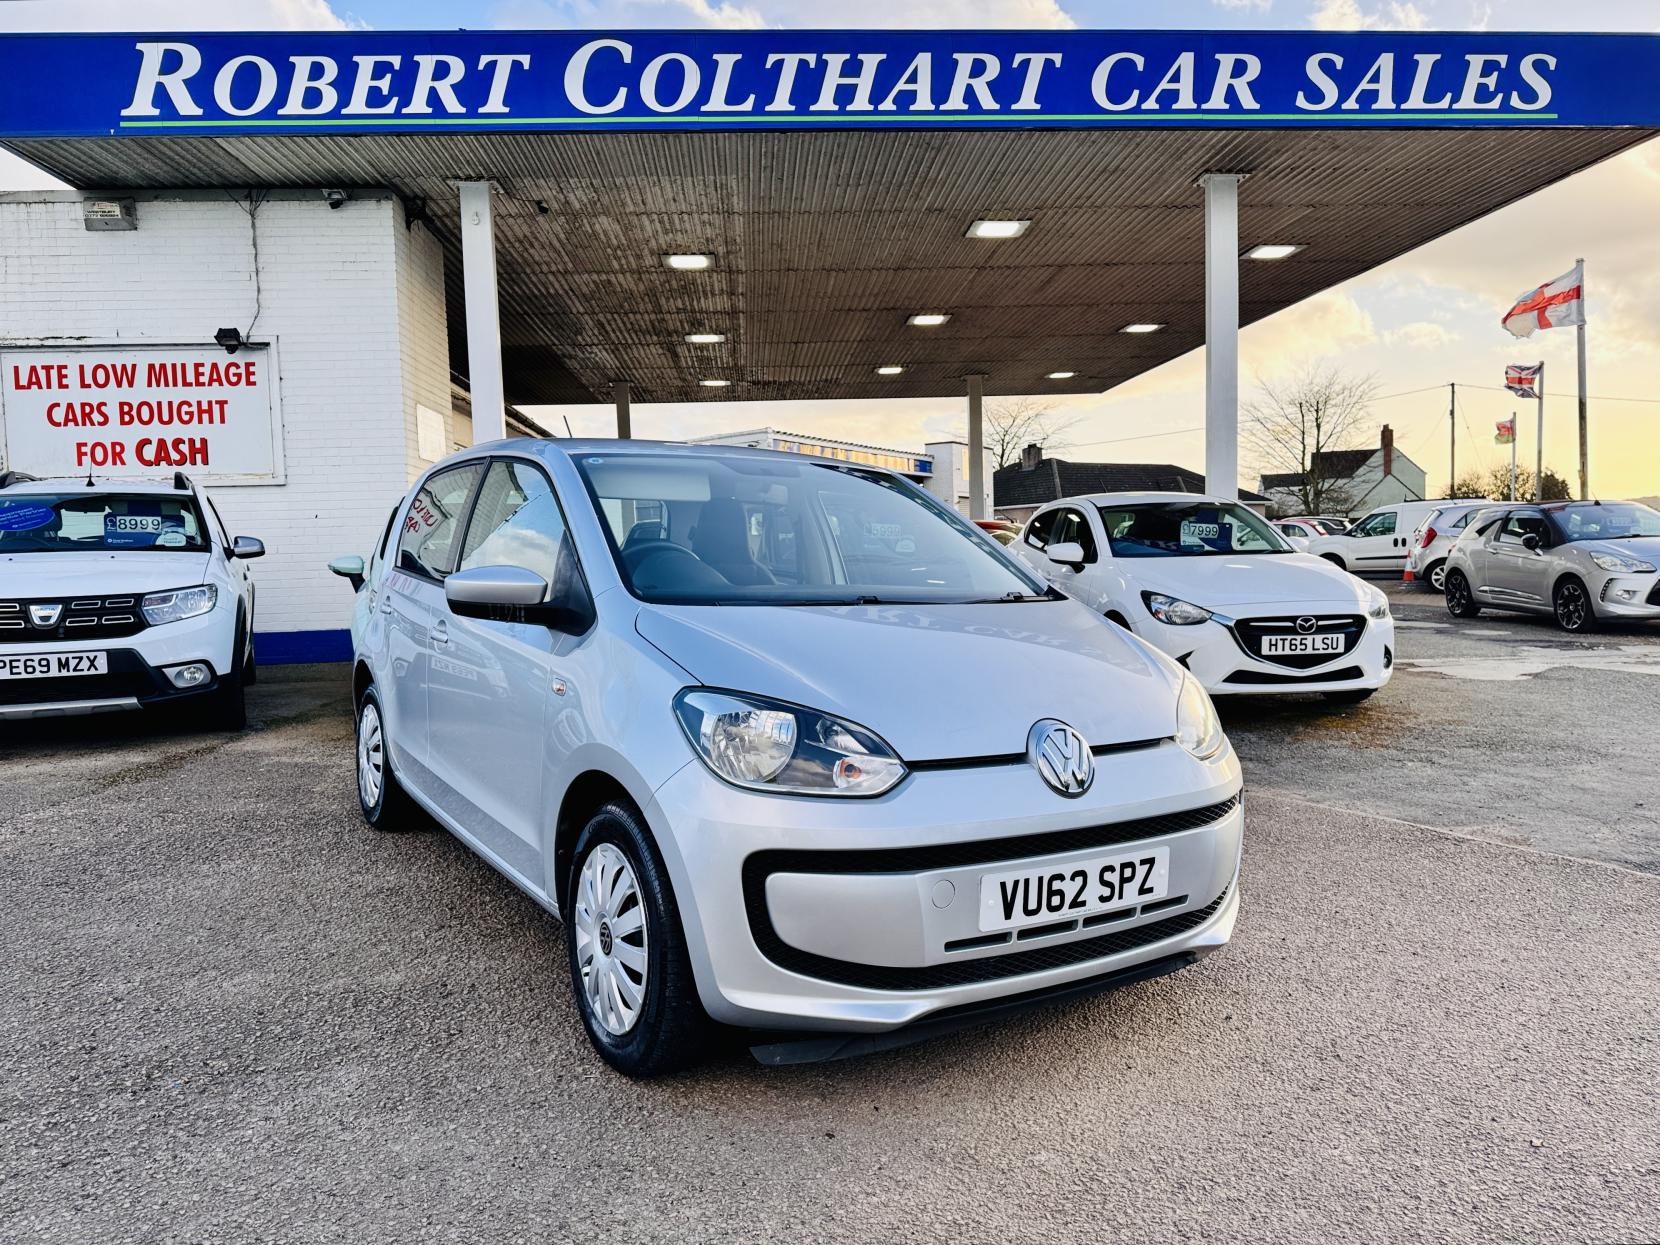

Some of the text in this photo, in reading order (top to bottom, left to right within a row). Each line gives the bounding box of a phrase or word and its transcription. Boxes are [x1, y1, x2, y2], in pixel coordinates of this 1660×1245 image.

[121, 39, 1557, 117] ROBERT COLTHART CAR SALES
[13, 361, 257, 390] LATE LOW MILEAGE
[46, 400, 229, 427] CARS BOUGHT
[75, 438, 209, 467] FOR CASH
[106, 516, 161, 531] £8999
[1268, 636, 1339, 652] HT65 LSU
[57, 655, 99, 673] MZX
[1000, 856, 1156, 921] VU62 SPZ
